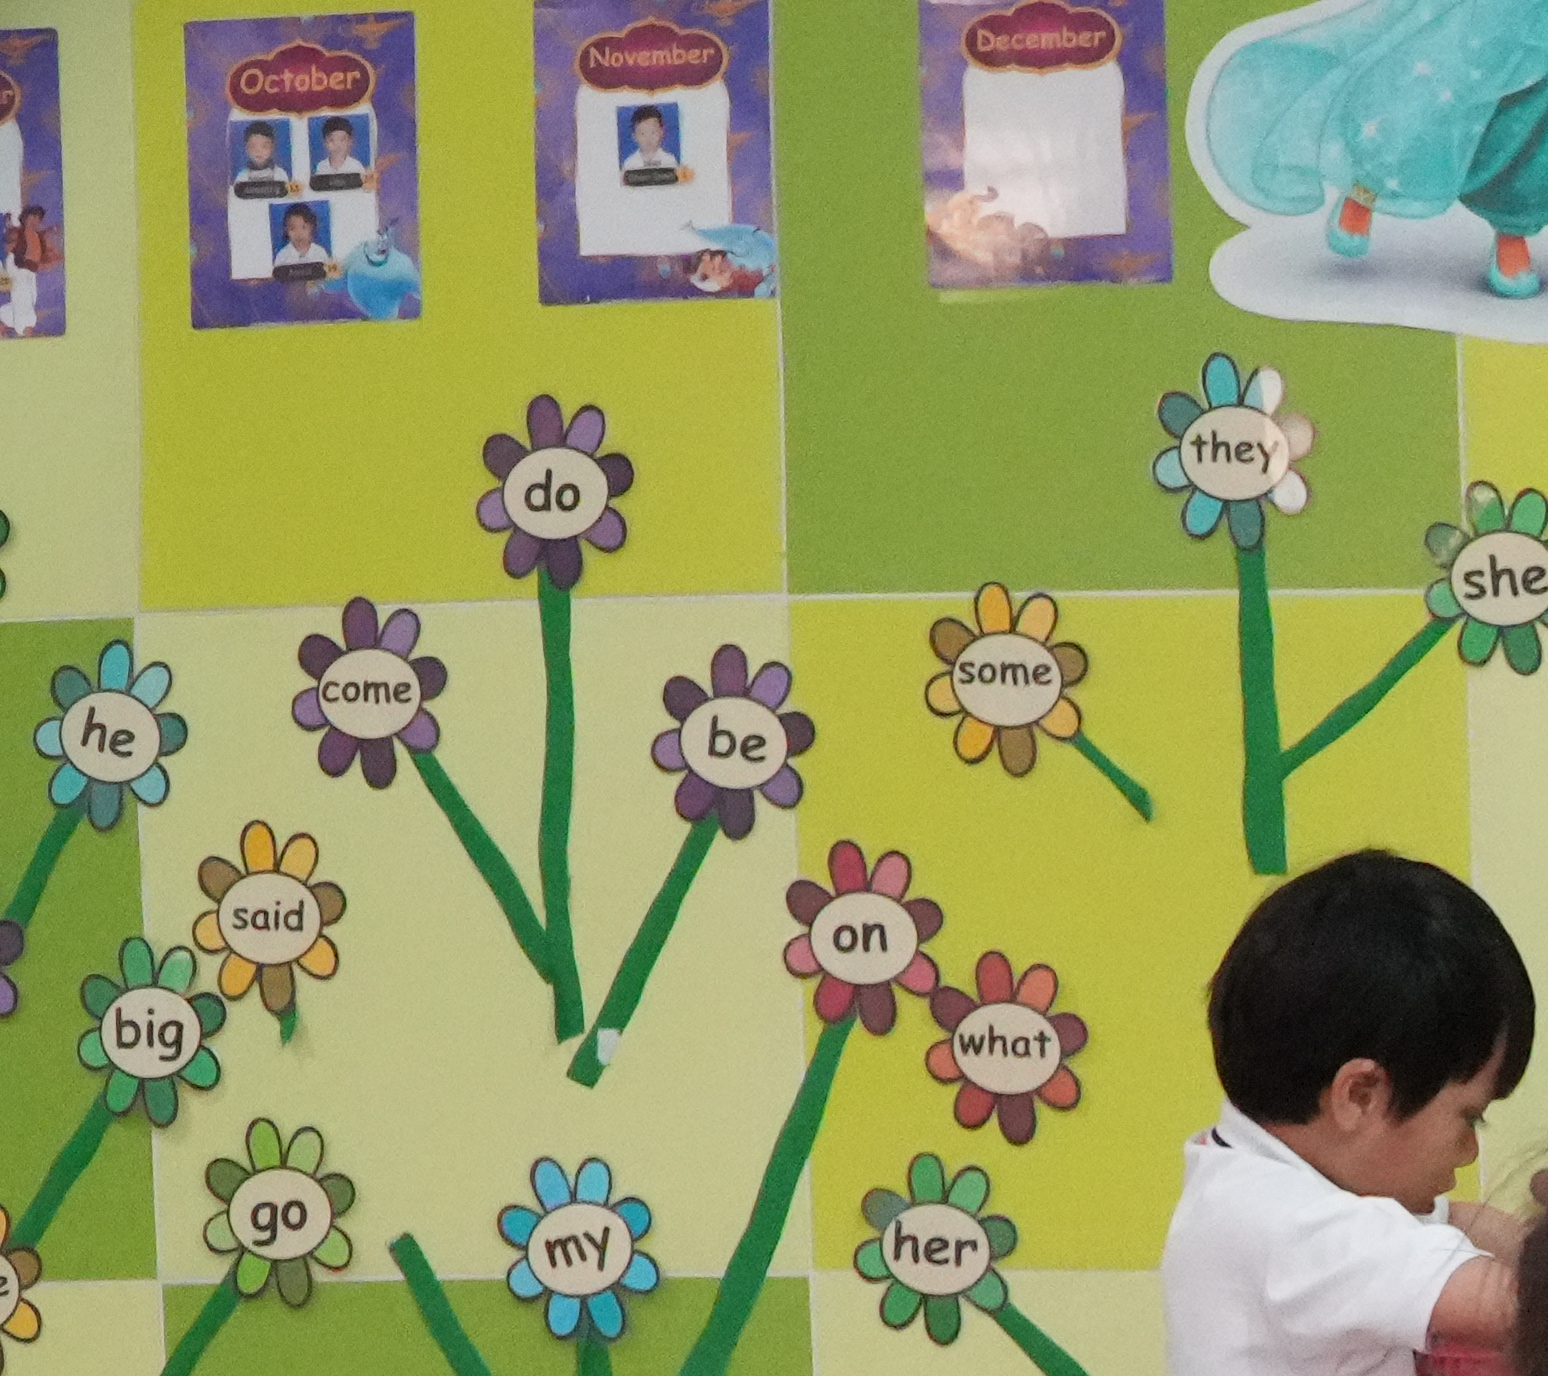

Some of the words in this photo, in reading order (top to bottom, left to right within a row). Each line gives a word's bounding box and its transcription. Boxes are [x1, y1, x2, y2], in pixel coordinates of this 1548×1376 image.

[589, 43, 715, 69] November
[976, 25, 1107, 51] December
[240, 63, 361, 95] October
[1189, 432, 1281, 474] they
[523, 468, 581, 513] do
[319, 674, 412, 706] come
[956, 656, 1054, 687] some
[80, 705, 136, 758] he
[707, 713, 767, 764] be
[231, 899, 306, 933] said
[832, 921, 889, 954] on
[114, 1006, 185, 1063] big
[957, 1025, 1053, 1061] what
[250, 1198, 309, 1246] go
[544, 1225, 611, 1272] my
[892, 1221, 980, 1268] her
